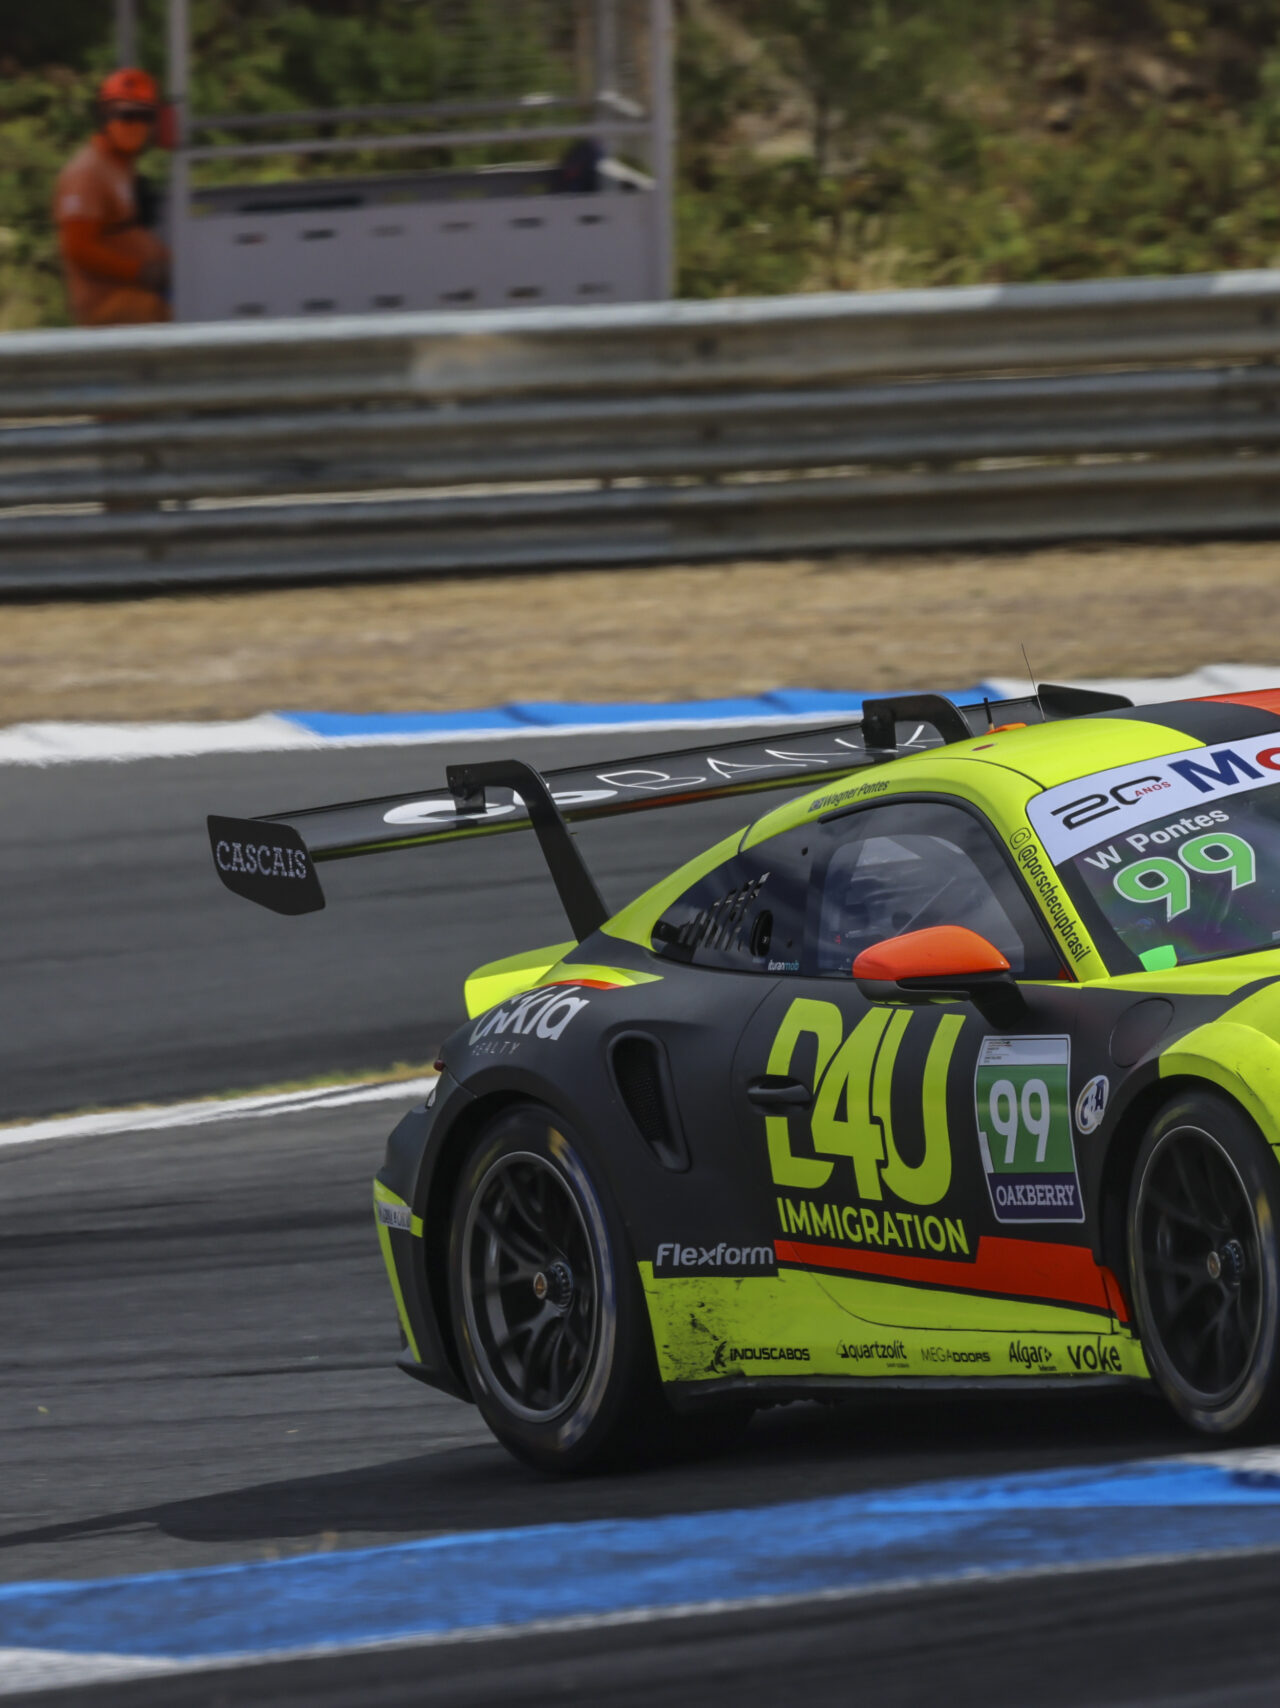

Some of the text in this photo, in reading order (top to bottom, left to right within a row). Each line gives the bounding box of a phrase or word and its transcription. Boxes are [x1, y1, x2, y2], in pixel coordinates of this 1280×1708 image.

[1134, 781, 1172, 798] ANOS
[216, 840, 307, 880] CASCAIS
[1083, 809, 1230, 871] W Pontes
[1112, 831, 1257, 923] 99
[1018, 844, 1092, 963] @porschecupbrasil
[989, 1078, 1050, 1164] 99
[995, 1184, 1075, 1207] OAKBERRY
[776, 1197, 971, 1256] IMMIGRATION
[655, 1242, 774, 1268] Flexform
[848, 1339, 908, 1362] quartzolit
[1009, 1339, 1044, 1369] Algar
